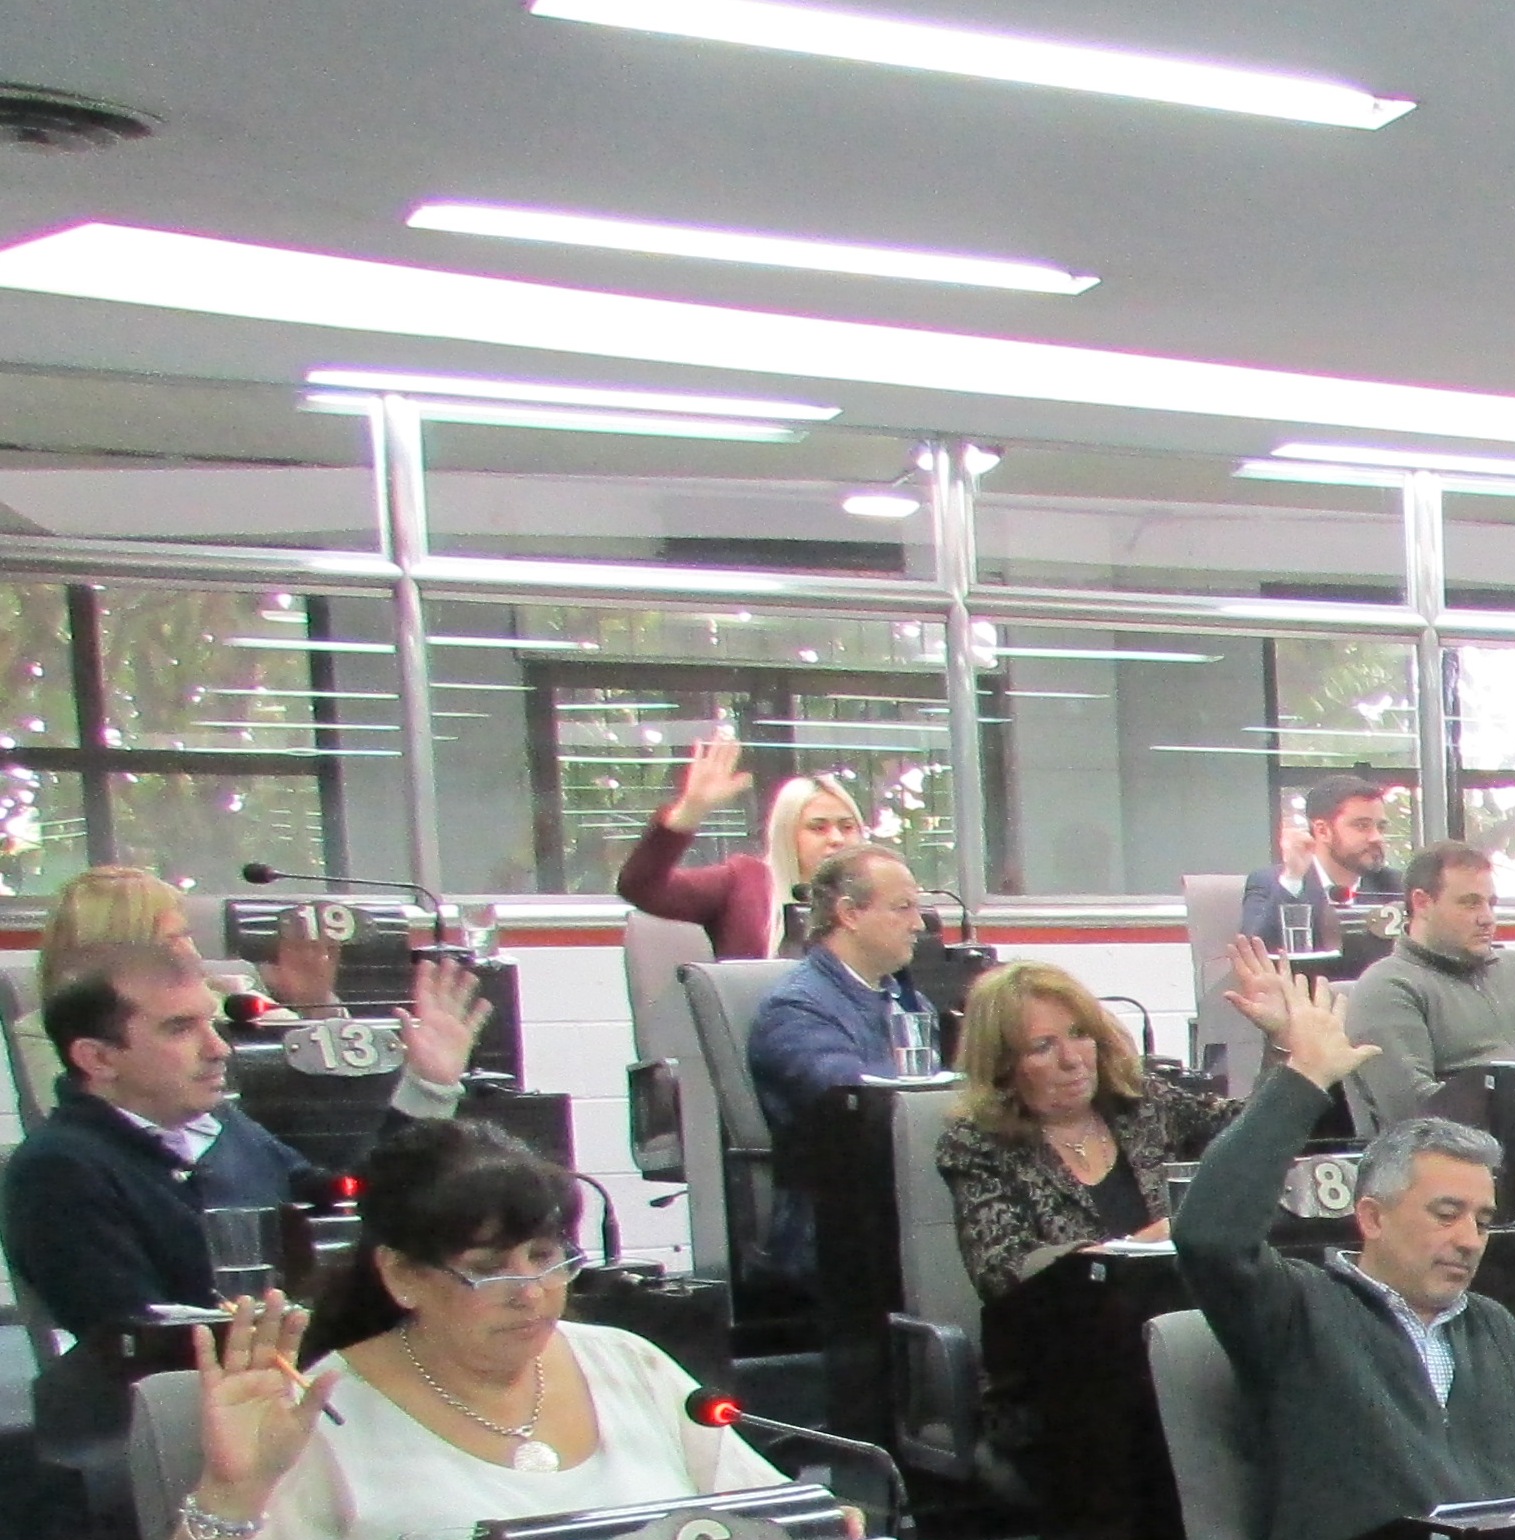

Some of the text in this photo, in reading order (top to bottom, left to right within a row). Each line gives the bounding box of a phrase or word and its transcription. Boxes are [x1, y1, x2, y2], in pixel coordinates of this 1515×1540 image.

[298, 905, 355, 940] 19
[310, 1025, 379, 1069] 13
[1315, 1162, 1350, 1209] 8
